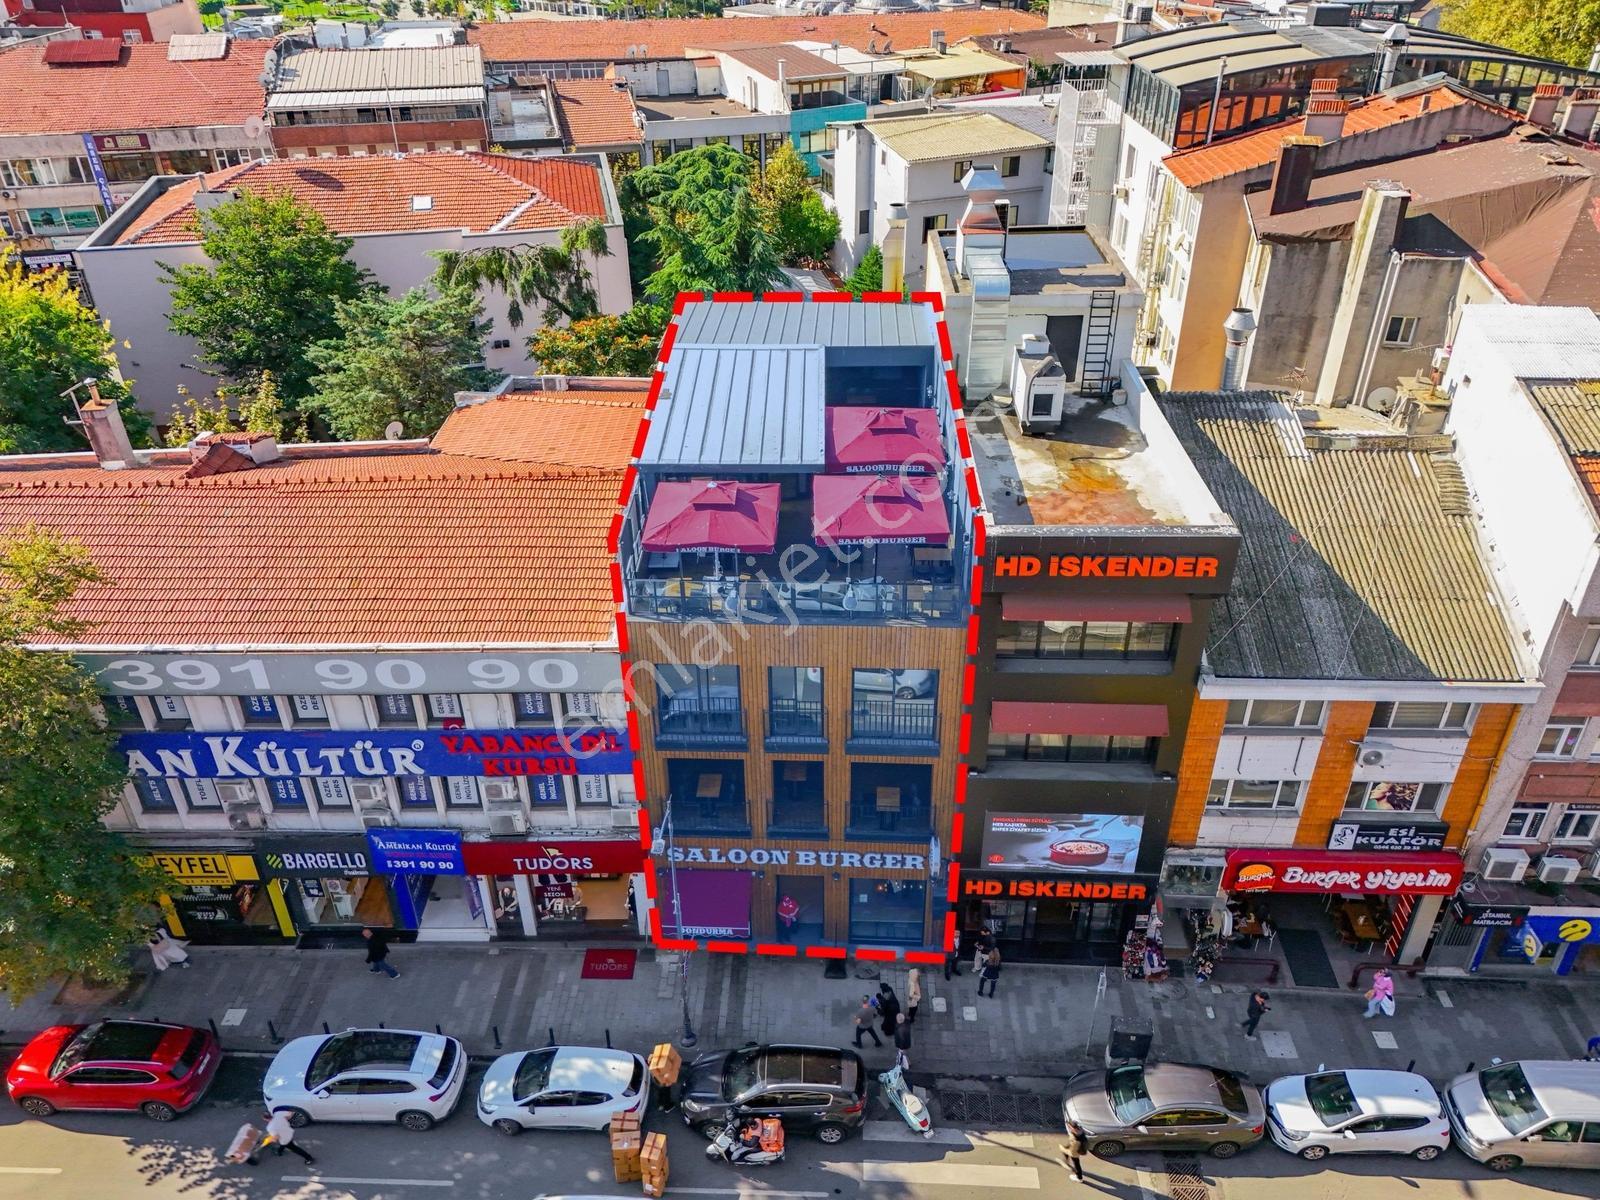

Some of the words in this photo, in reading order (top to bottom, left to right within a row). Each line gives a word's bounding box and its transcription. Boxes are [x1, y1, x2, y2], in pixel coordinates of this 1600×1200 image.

[995, 556, 1042, 577] HD
[108, 659, 271, 691] 391
[315, 659, 426, 690] 90
[467, 658, 579, 689] 90
[250, 695, 261, 711] ÖZE
[261, 695, 272, 711] DER
[299, 695, 308, 711] ÖZE
[310, 695, 320, 710] DER
[439, 735, 569, 754] YABANCI
[203, 735, 425, 777] KÜLTÜR
[482, 758, 579, 777] KURSU
[425, 841, 457, 852] KÜLTÜR
[1355, 836, 1441, 847] KUAFÖR
[282, 852, 367, 870] BARGELLO
[392, 860, 415, 869] 391
[419, 861, 435, 869] 90
[438, 861, 454, 870] 90
[513, 858, 593, 870] TUDORS
[666, 847, 790, 866] SALOON
[795, 849, 925, 870] BURGER
[965, 880, 1003, 896] HD
